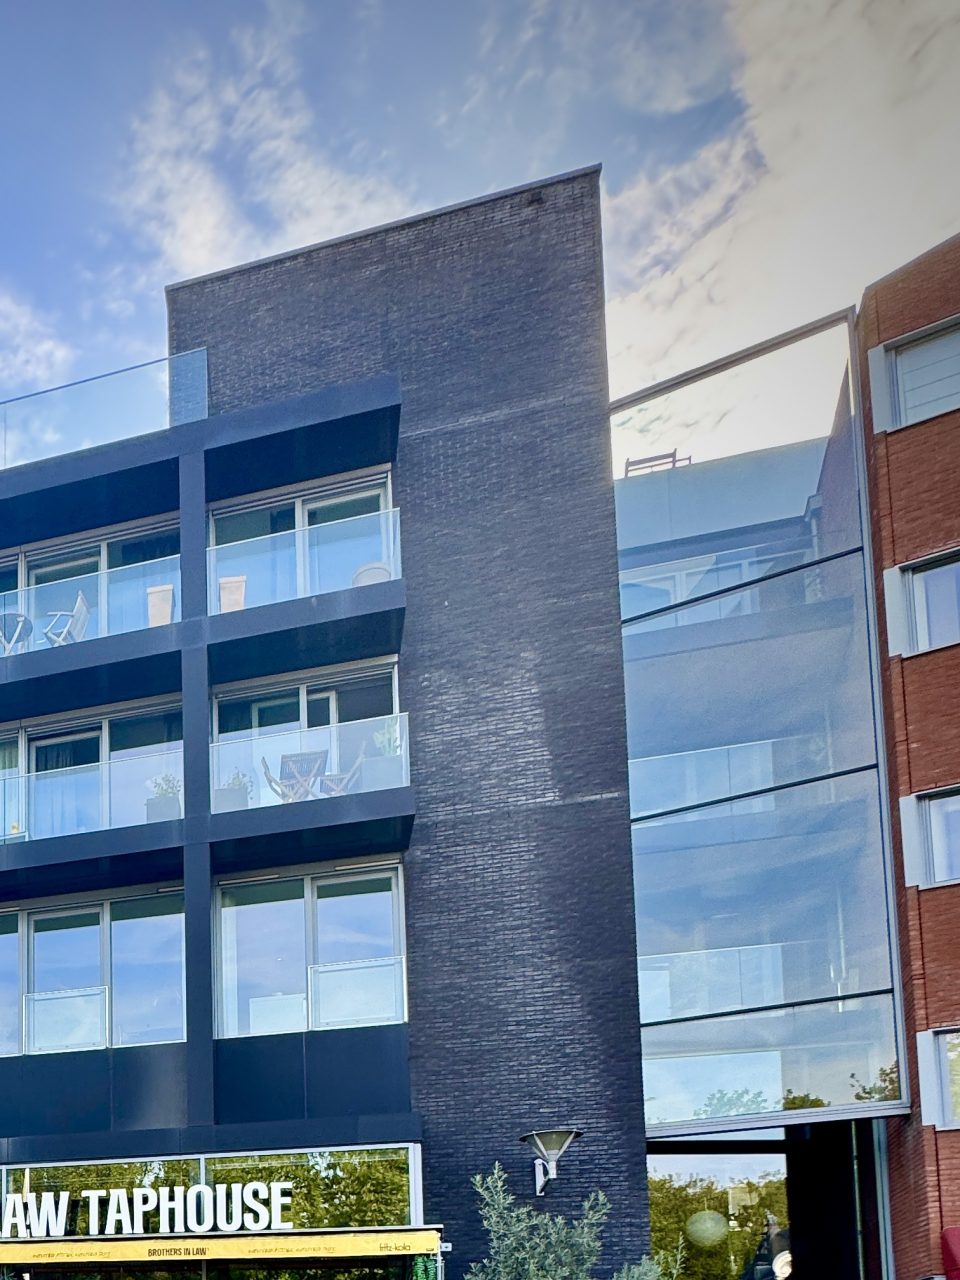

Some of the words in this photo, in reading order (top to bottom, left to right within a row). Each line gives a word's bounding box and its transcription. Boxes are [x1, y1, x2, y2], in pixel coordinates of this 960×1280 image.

[81, 1181, 294, 1235] TAPHOUSE
[148, 1248, 182, 1256] BROTHERS
[183, 1248, 191, 1256] IN
[192, 1247, 207, 1256] LAW
